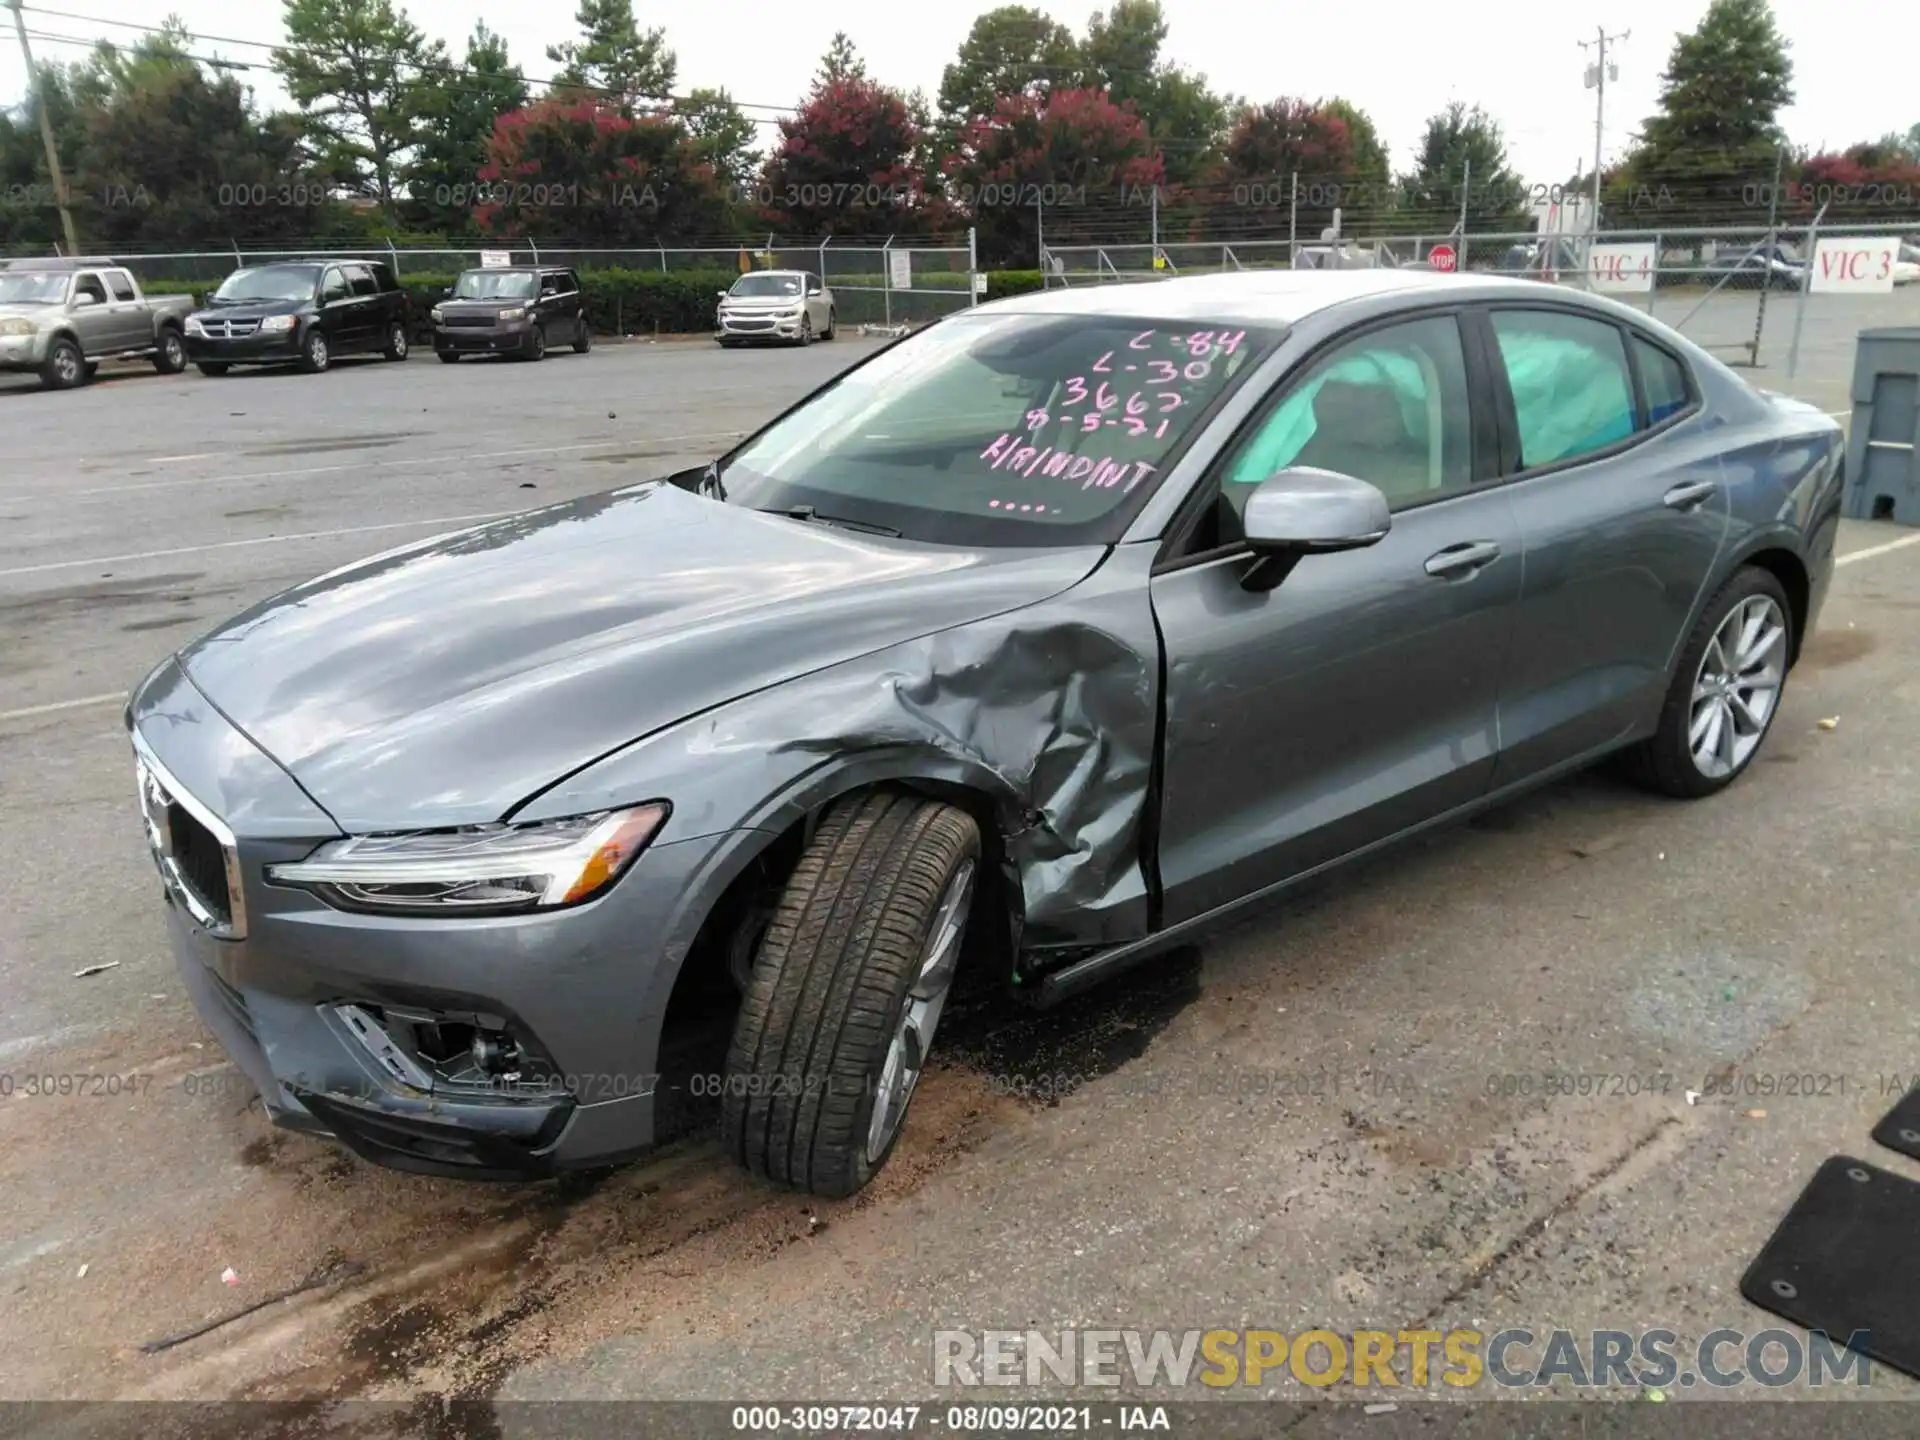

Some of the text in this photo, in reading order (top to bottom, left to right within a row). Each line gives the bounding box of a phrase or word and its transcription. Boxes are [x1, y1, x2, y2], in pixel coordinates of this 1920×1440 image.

[1593, 253, 1651, 282] VIC 4
[1821, 249, 1892, 281] VIC 3
